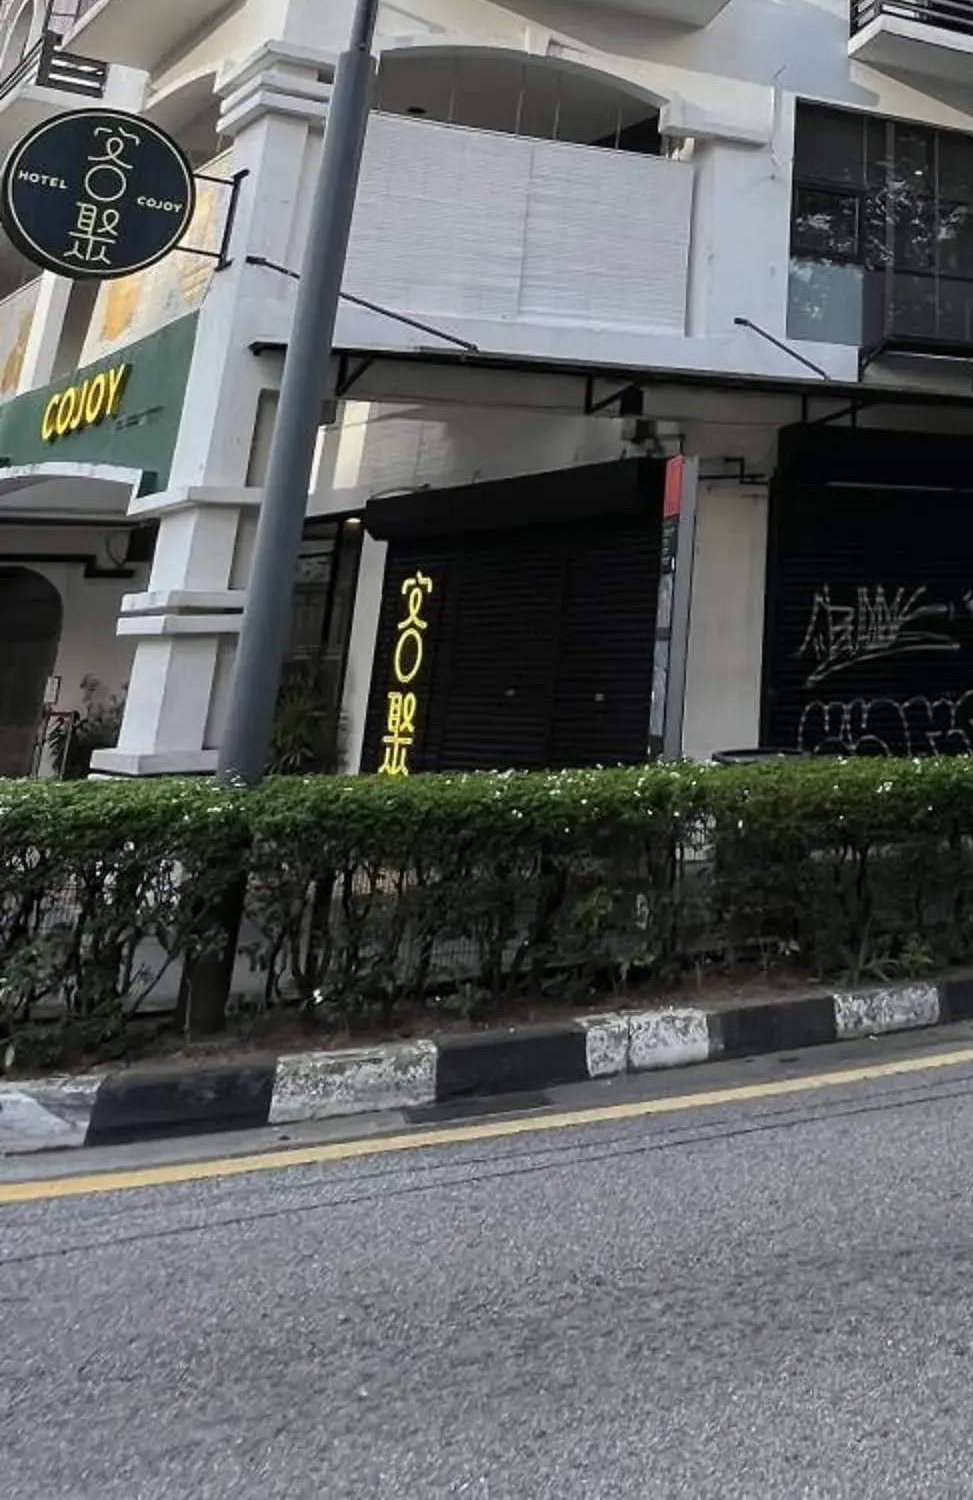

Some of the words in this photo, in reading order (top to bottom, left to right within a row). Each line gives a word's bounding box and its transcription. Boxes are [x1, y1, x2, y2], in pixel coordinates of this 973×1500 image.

[18, 169, 68, 190] HOTEL
[136, 195, 183, 213] COJOY
[41, 363, 128, 442] COJOY
